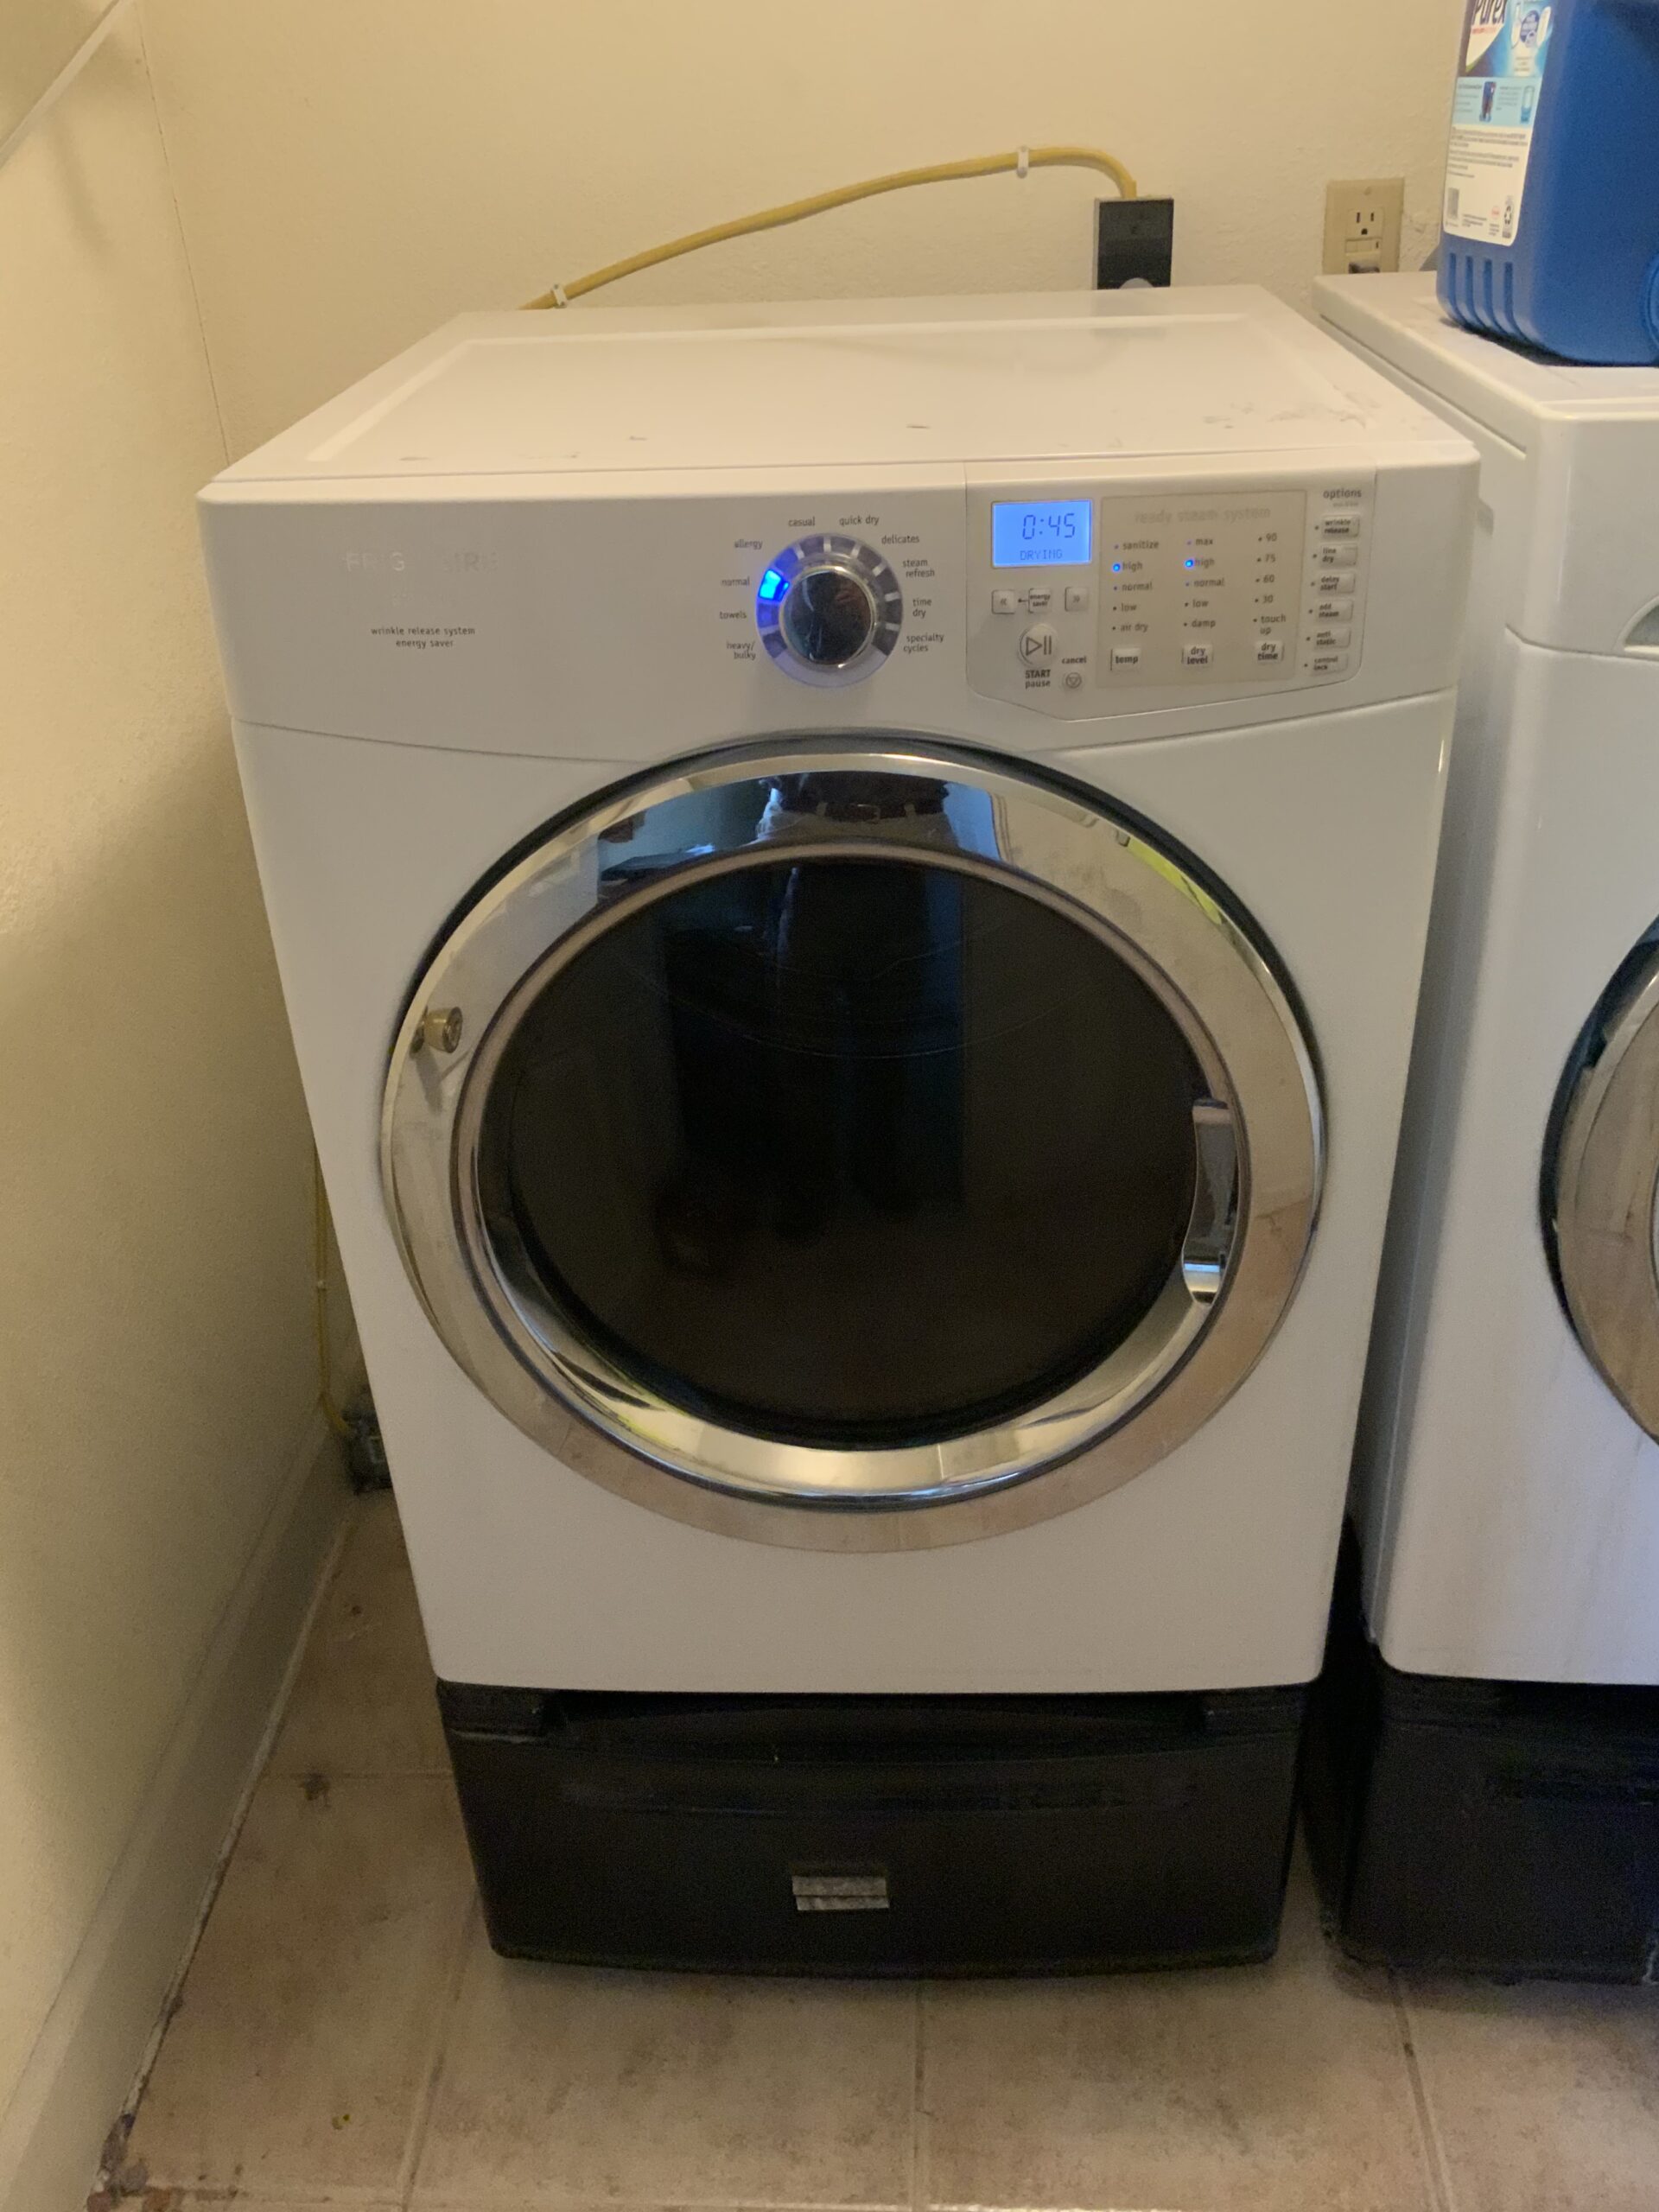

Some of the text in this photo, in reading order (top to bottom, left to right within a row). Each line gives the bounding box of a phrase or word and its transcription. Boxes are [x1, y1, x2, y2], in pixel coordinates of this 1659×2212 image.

[1323, 488, 1362, 500] options
[788, 517, 816, 527] casual
[839, 515, 880, 526] quick dry
[1022, 513, 1077, 540] 0:45
[881, 535, 920, 544] delicates
[1195, 537, 1213, 546] max
[1265, 532, 1278, 543] 90
[734, 539, 763, 550] allergy
[1122, 539, 1160, 550] sanitize
[1020, 549, 1063, 561] DRYING
[1264, 553, 1276, 563] 75
[902, 559, 928, 568] steam
[1122, 560, 1143, 572] high
[1195, 558, 1215, 569] high
[906, 568, 935, 577] refresh
[721, 575, 750, 586] normal
[1193, 577, 1225, 588] normal
[1122, 582, 1153, 592] normal
[912, 597, 932, 607] time
[1121, 601, 1137, 613] low
[1192, 598, 1210, 608] low
[719, 611, 747, 620] towels
[912, 608, 926, 620] dry
[1261, 614, 1287, 625] touch
[1120, 622, 1148, 633] air dry
[1192, 619, 1216, 630] damp
[371, 626, 475, 638] wrinkle release system
[1260, 626, 1272, 637] up
[906, 632, 944, 644] specialty
[396, 639, 454, 649] energy saver
[727, 640, 755, 652] heavy/
[903, 645, 929, 654] cycles
[1261, 643, 1276, 653] dry
[734, 651, 756, 661] bulky
[1191, 646, 1206, 656] dry
[1061, 655, 1088, 664] cancel
[1115, 654, 1139, 665] temp
[1187, 655, 1209, 665] level
[1257, 652, 1279, 662] time
[1025, 669, 1052, 680] START
[1025, 679, 1052, 690] pause
